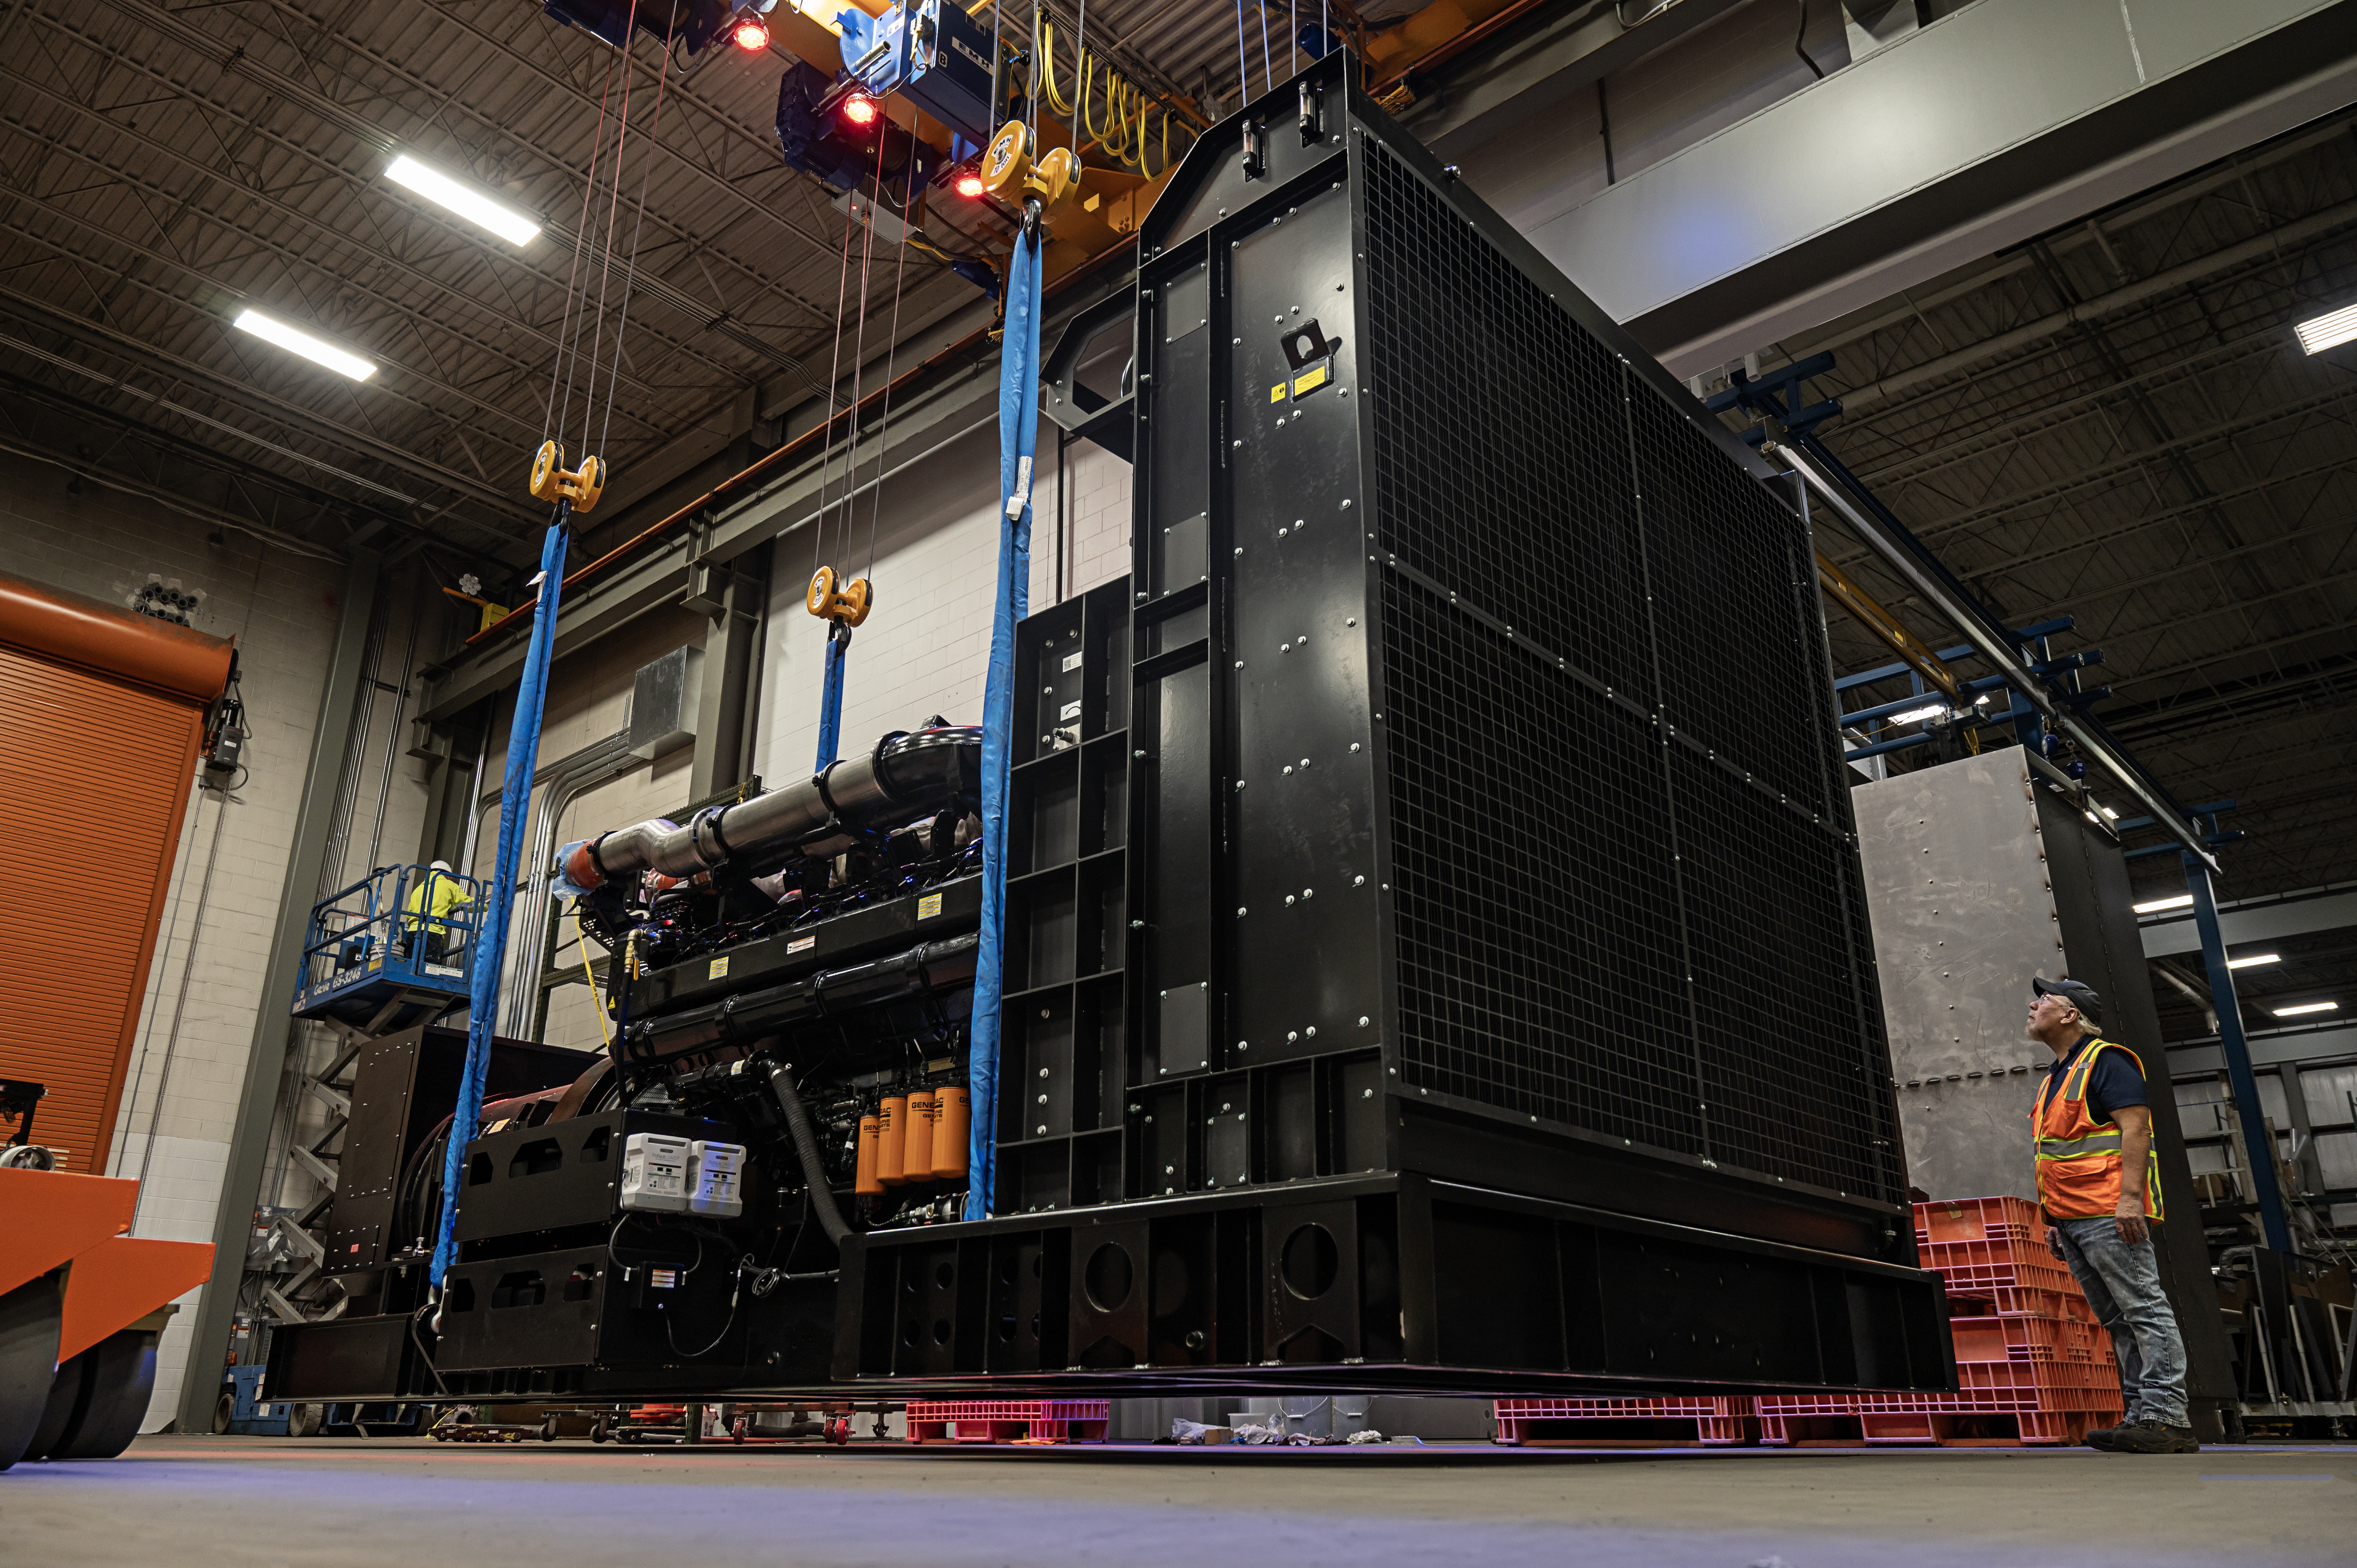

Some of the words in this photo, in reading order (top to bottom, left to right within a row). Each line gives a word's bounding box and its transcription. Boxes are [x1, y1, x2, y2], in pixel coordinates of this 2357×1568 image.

[940, 55, 946, 64] B
[994, 166, 1000, 174] 10
[314, 981, 330, 996] Genie
[333, 967, 361, 988] GS-3246
